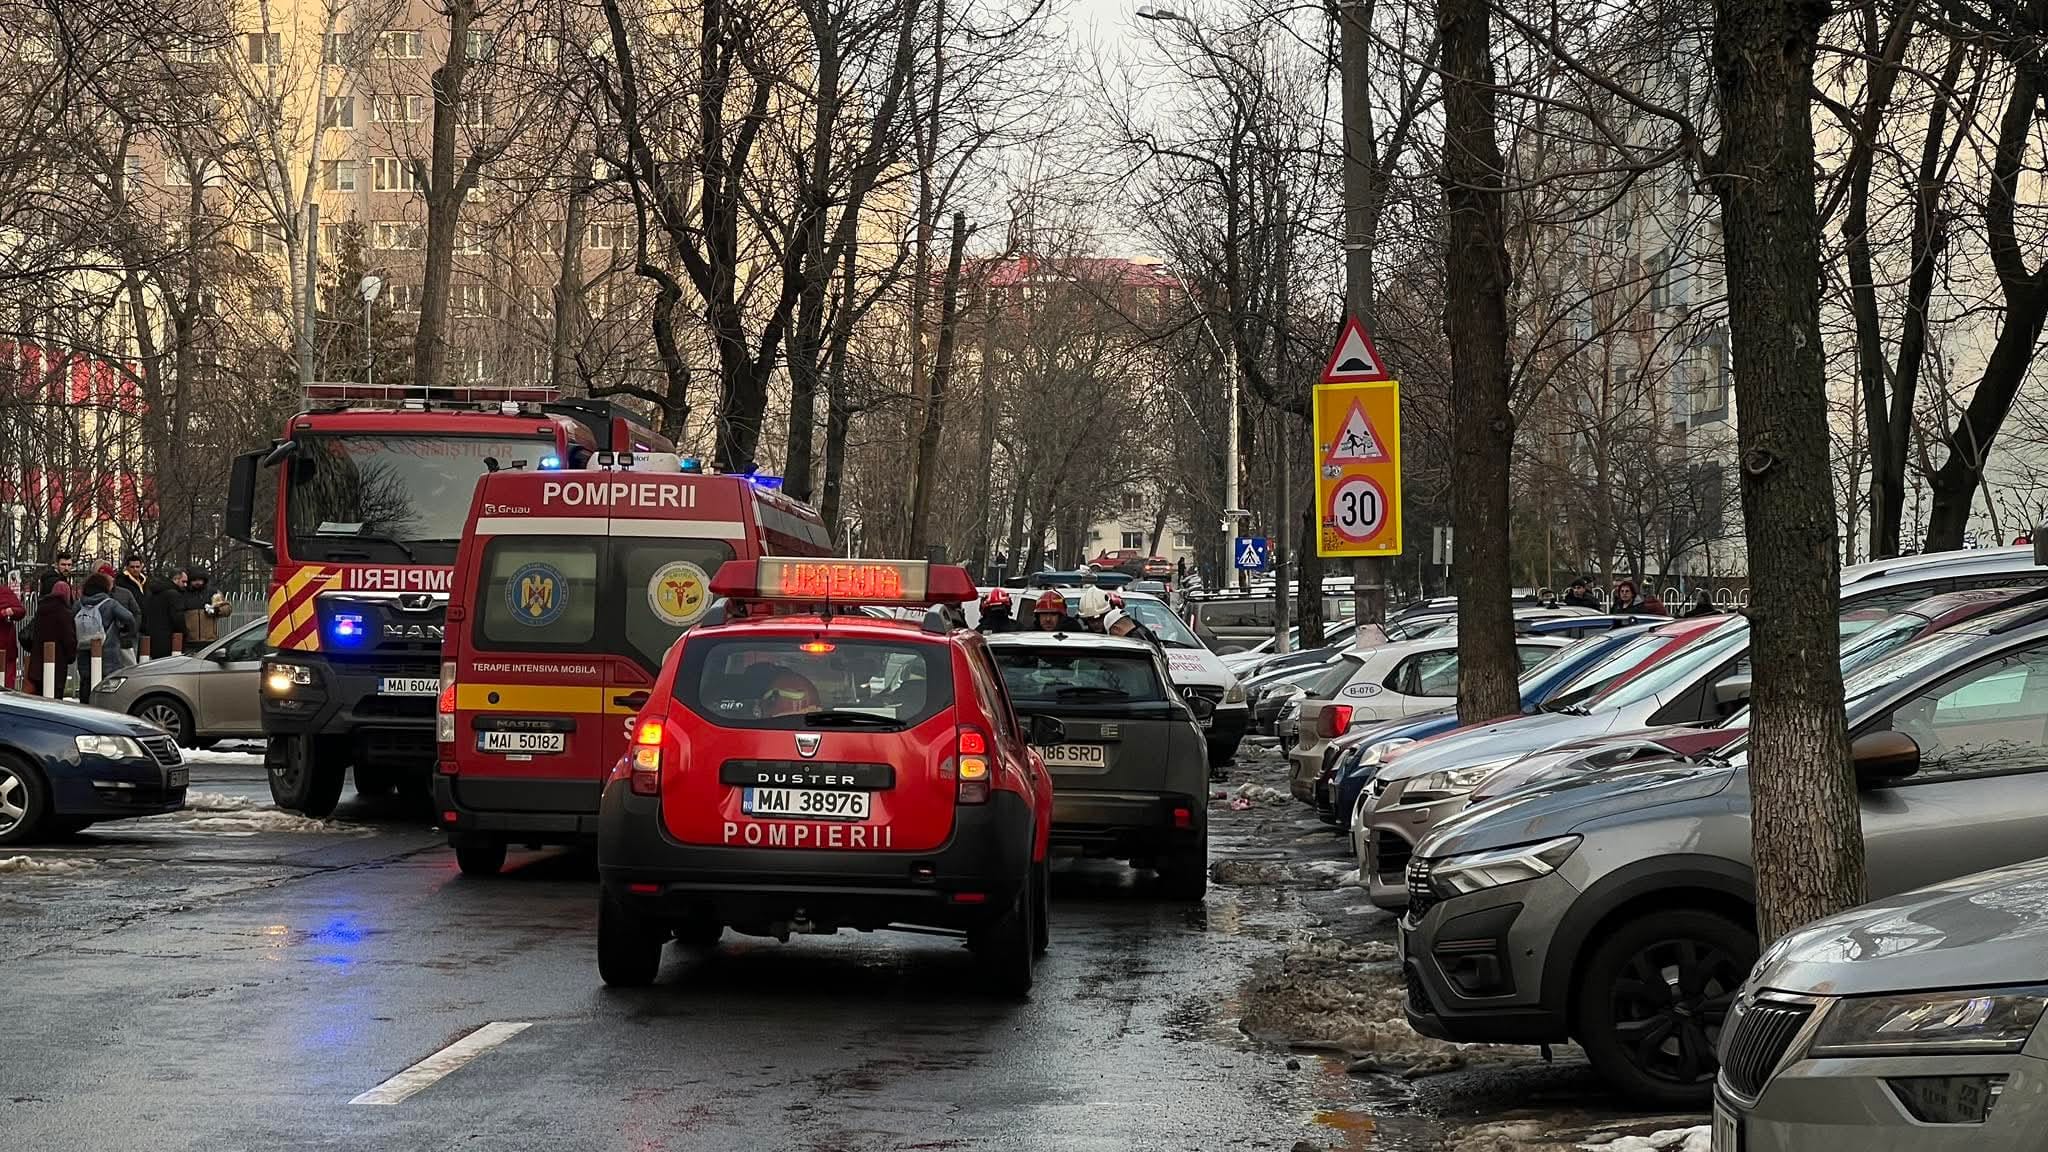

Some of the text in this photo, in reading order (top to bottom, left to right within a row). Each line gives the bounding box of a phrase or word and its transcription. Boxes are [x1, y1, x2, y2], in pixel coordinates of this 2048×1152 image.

[543, 482, 695, 508] POMPIERII
[498, 504, 530, 514] Gruau
[1341, 490, 1376, 527] 30
[383, 624, 444, 639] MAN
[472, 663, 596, 674] TERAPIE INTENSIVA MOBILA
[388, 680, 407, 691] MAI
[1350, 686, 1375, 695] B-076
[489, 733, 560, 750] MAI 50182
[1068, 746, 1102, 761] SRD
[757, 773, 856, 785] DUSTER
[758, 790, 790, 812] MAI
[799, 791, 864, 814] 38976
[723, 822, 892, 848] POMPIERII
